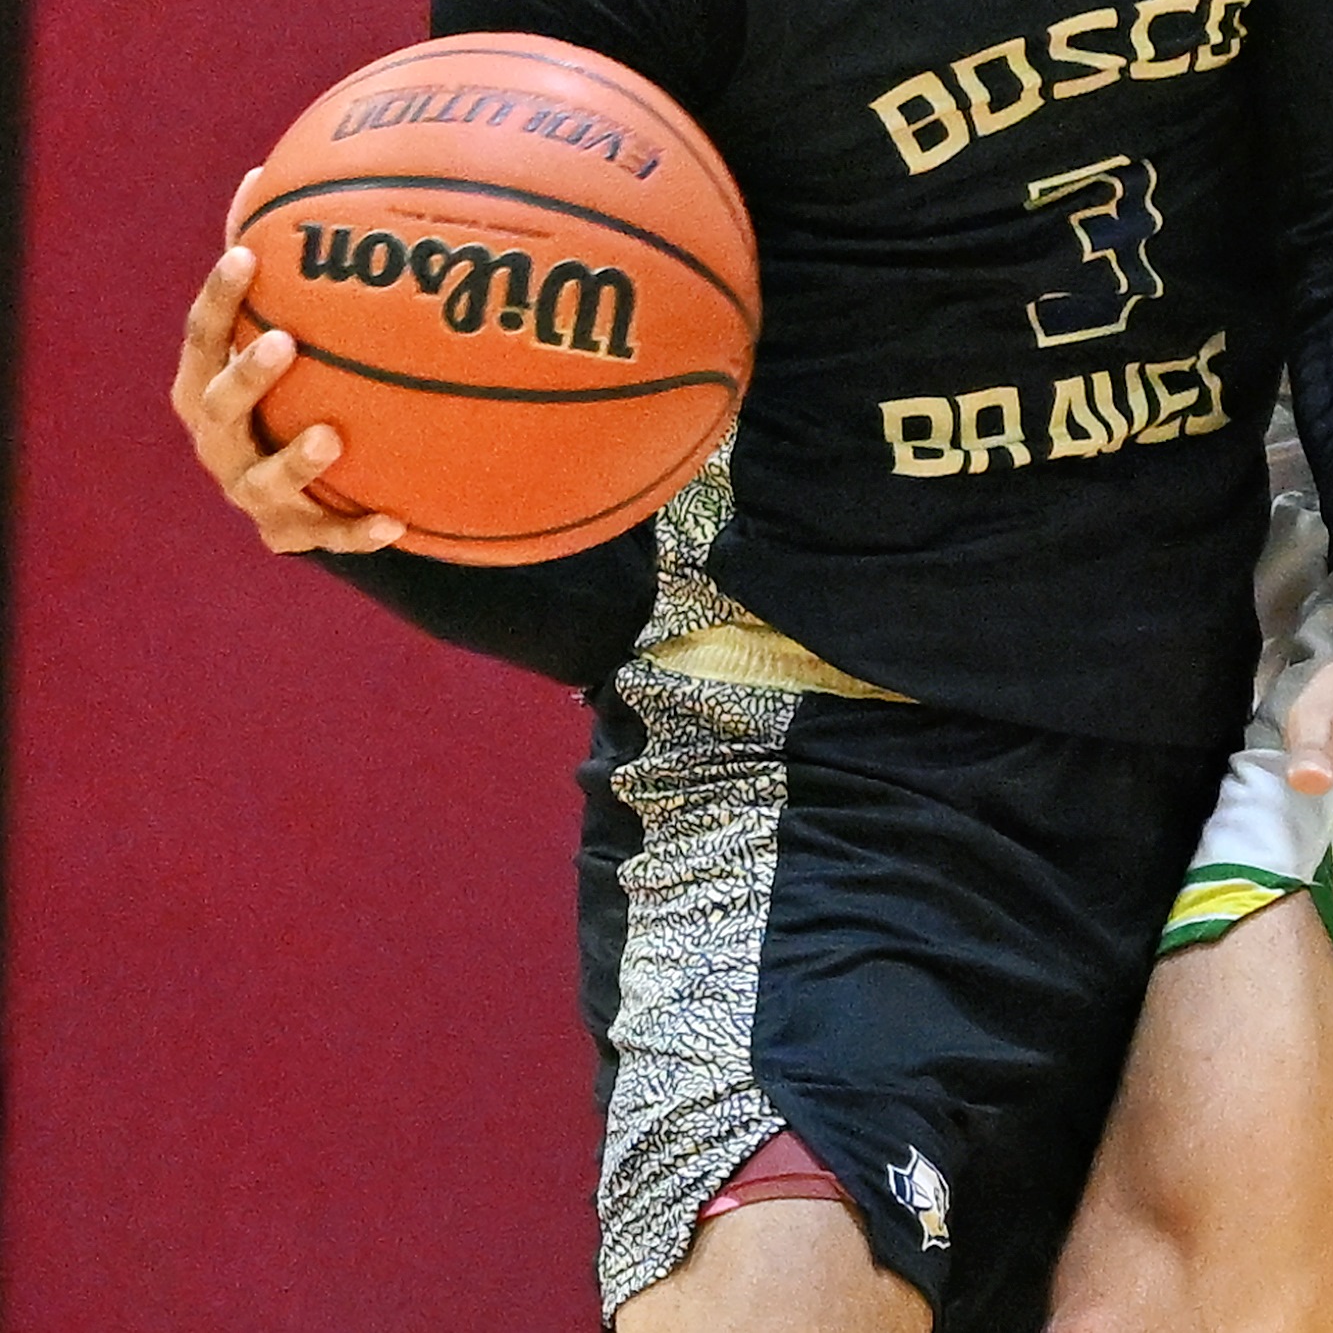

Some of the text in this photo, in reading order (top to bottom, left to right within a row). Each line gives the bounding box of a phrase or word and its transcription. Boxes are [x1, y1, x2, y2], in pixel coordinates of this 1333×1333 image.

[297, 221, 638, 363] Wilson
[1023, 154, 1165, 349] 3
[878, 330, 1231, 479] BRAVES
